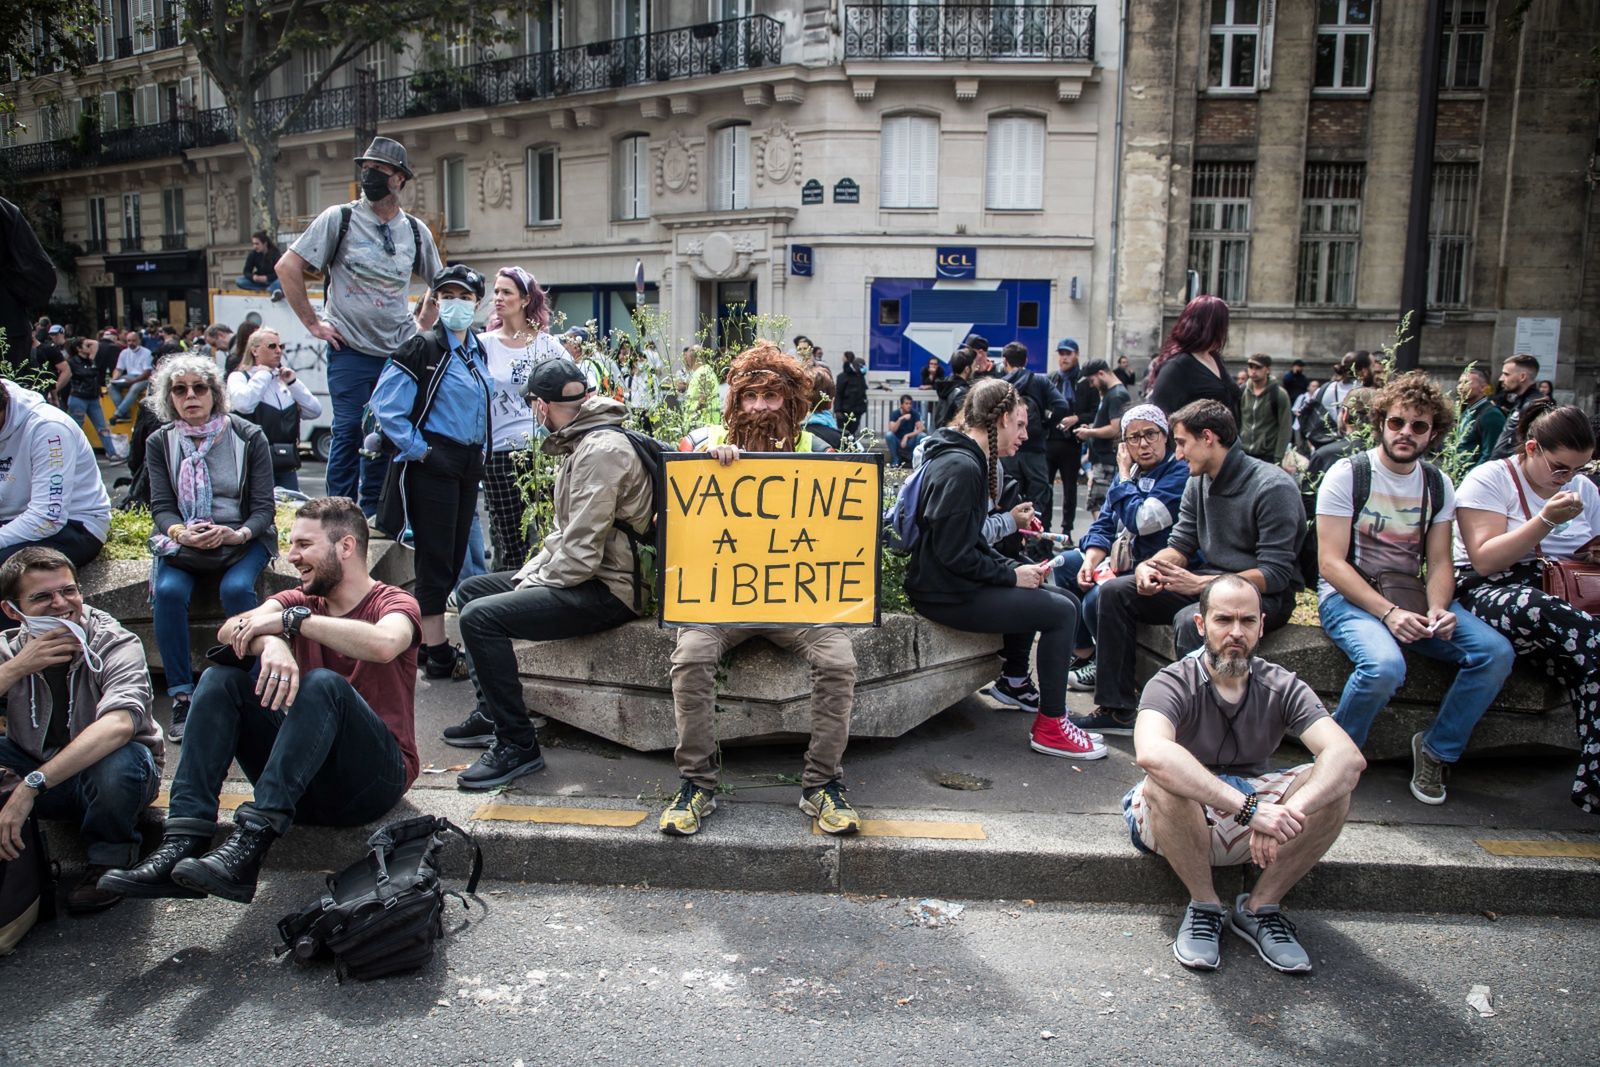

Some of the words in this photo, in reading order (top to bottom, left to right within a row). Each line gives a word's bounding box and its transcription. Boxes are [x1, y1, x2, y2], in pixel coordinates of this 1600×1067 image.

[792, 252, 809, 264] LCL
[939, 254, 972, 265] LCL
[48, 435, 63, 468] THE
[669, 466, 867, 521] VACCINÉ
[712, 527, 738, 554] A
[767, 527, 820, 554] LA
[677, 547, 866, 606] LIBERTÉ
